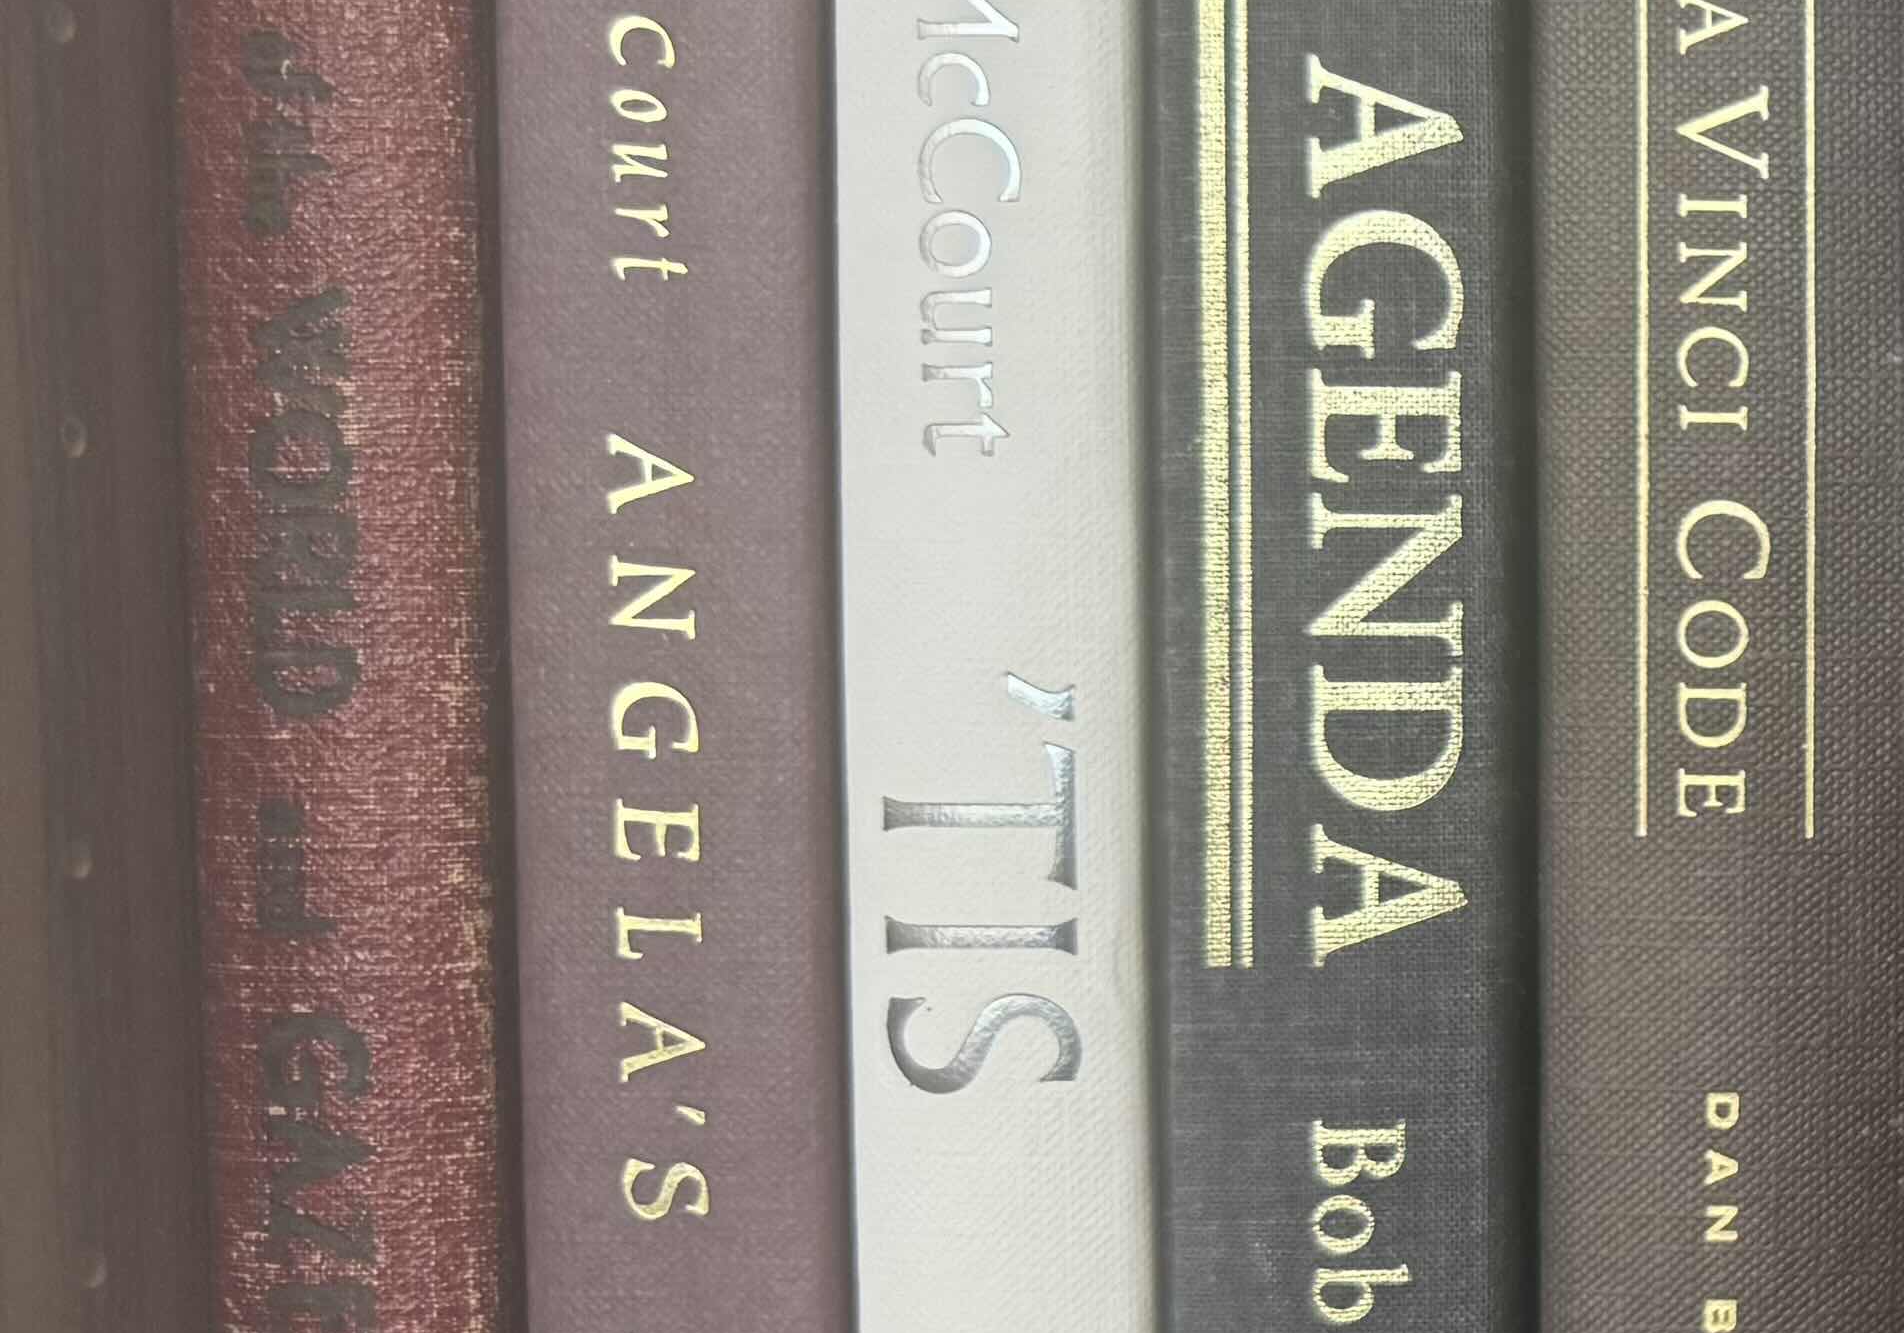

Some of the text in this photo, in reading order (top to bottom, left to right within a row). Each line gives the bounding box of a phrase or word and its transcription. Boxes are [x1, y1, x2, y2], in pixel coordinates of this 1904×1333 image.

[1673, 85, 1769, 432] VINCI
[250, 285, 360, 718] WORLD
[1304, 53, 1468, 968] AGENDA
[1674, 498, 1771, 819] CODE
[606, 432, 710, 1224] ANGELA'S
[1309, 1117, 1412, 1324] Bob
[1703, 1091, 1741, 1244] DAN
